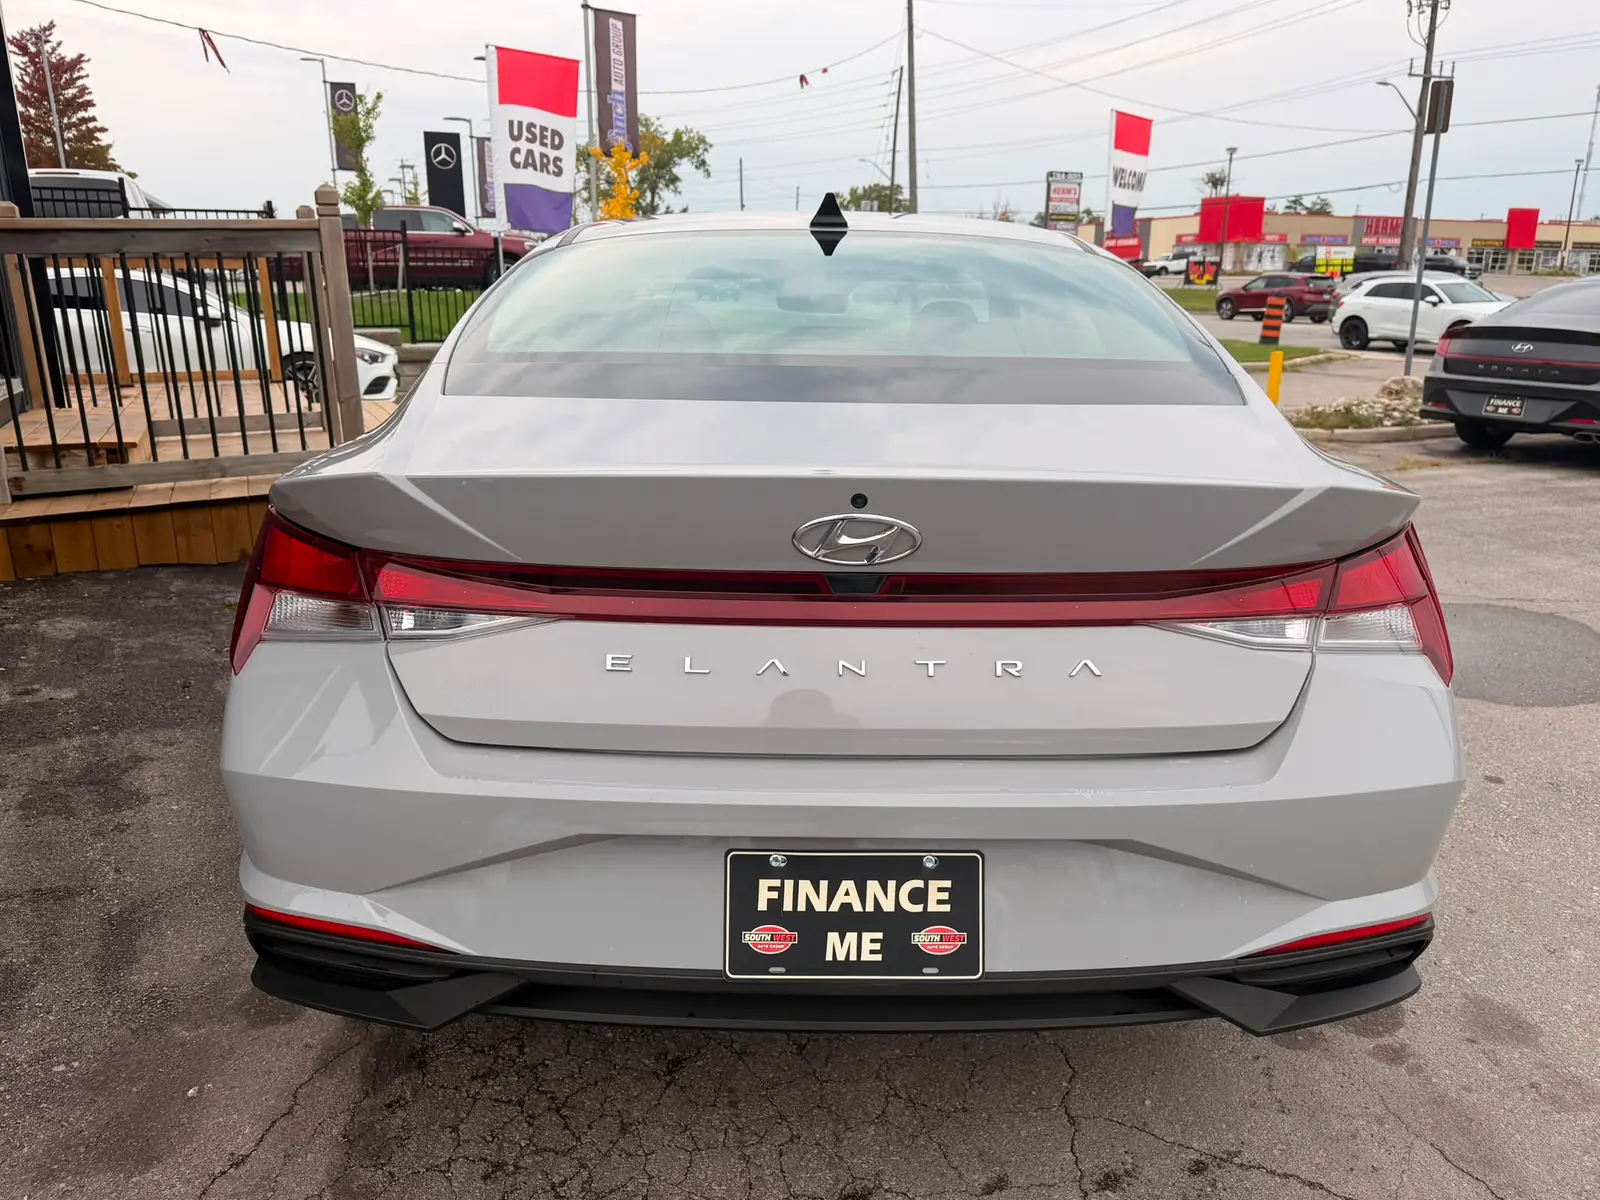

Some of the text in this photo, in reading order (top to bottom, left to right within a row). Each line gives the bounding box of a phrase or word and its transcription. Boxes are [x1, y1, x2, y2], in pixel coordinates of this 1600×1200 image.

[611, 23, 622, 57] GROUP
[612, 59, 624, 86] AUTO
[508, 119, 565, 151] USED
[509, 146, 564, 178] CARS
[1112, 165, 1147, 192] WELCOM
[1363, 217, 1403, 235] HERM
[1490, 399, 1522, 407] FINANCE
[604, 653, 1103, 678] ELANTRA
[757, 879, 952, 912] FINANCE
[744, 933, 796, 942] SOUTH WEST
[825, 931, 883, 962] ME
[913, 934, 941, 942] SOUTH
